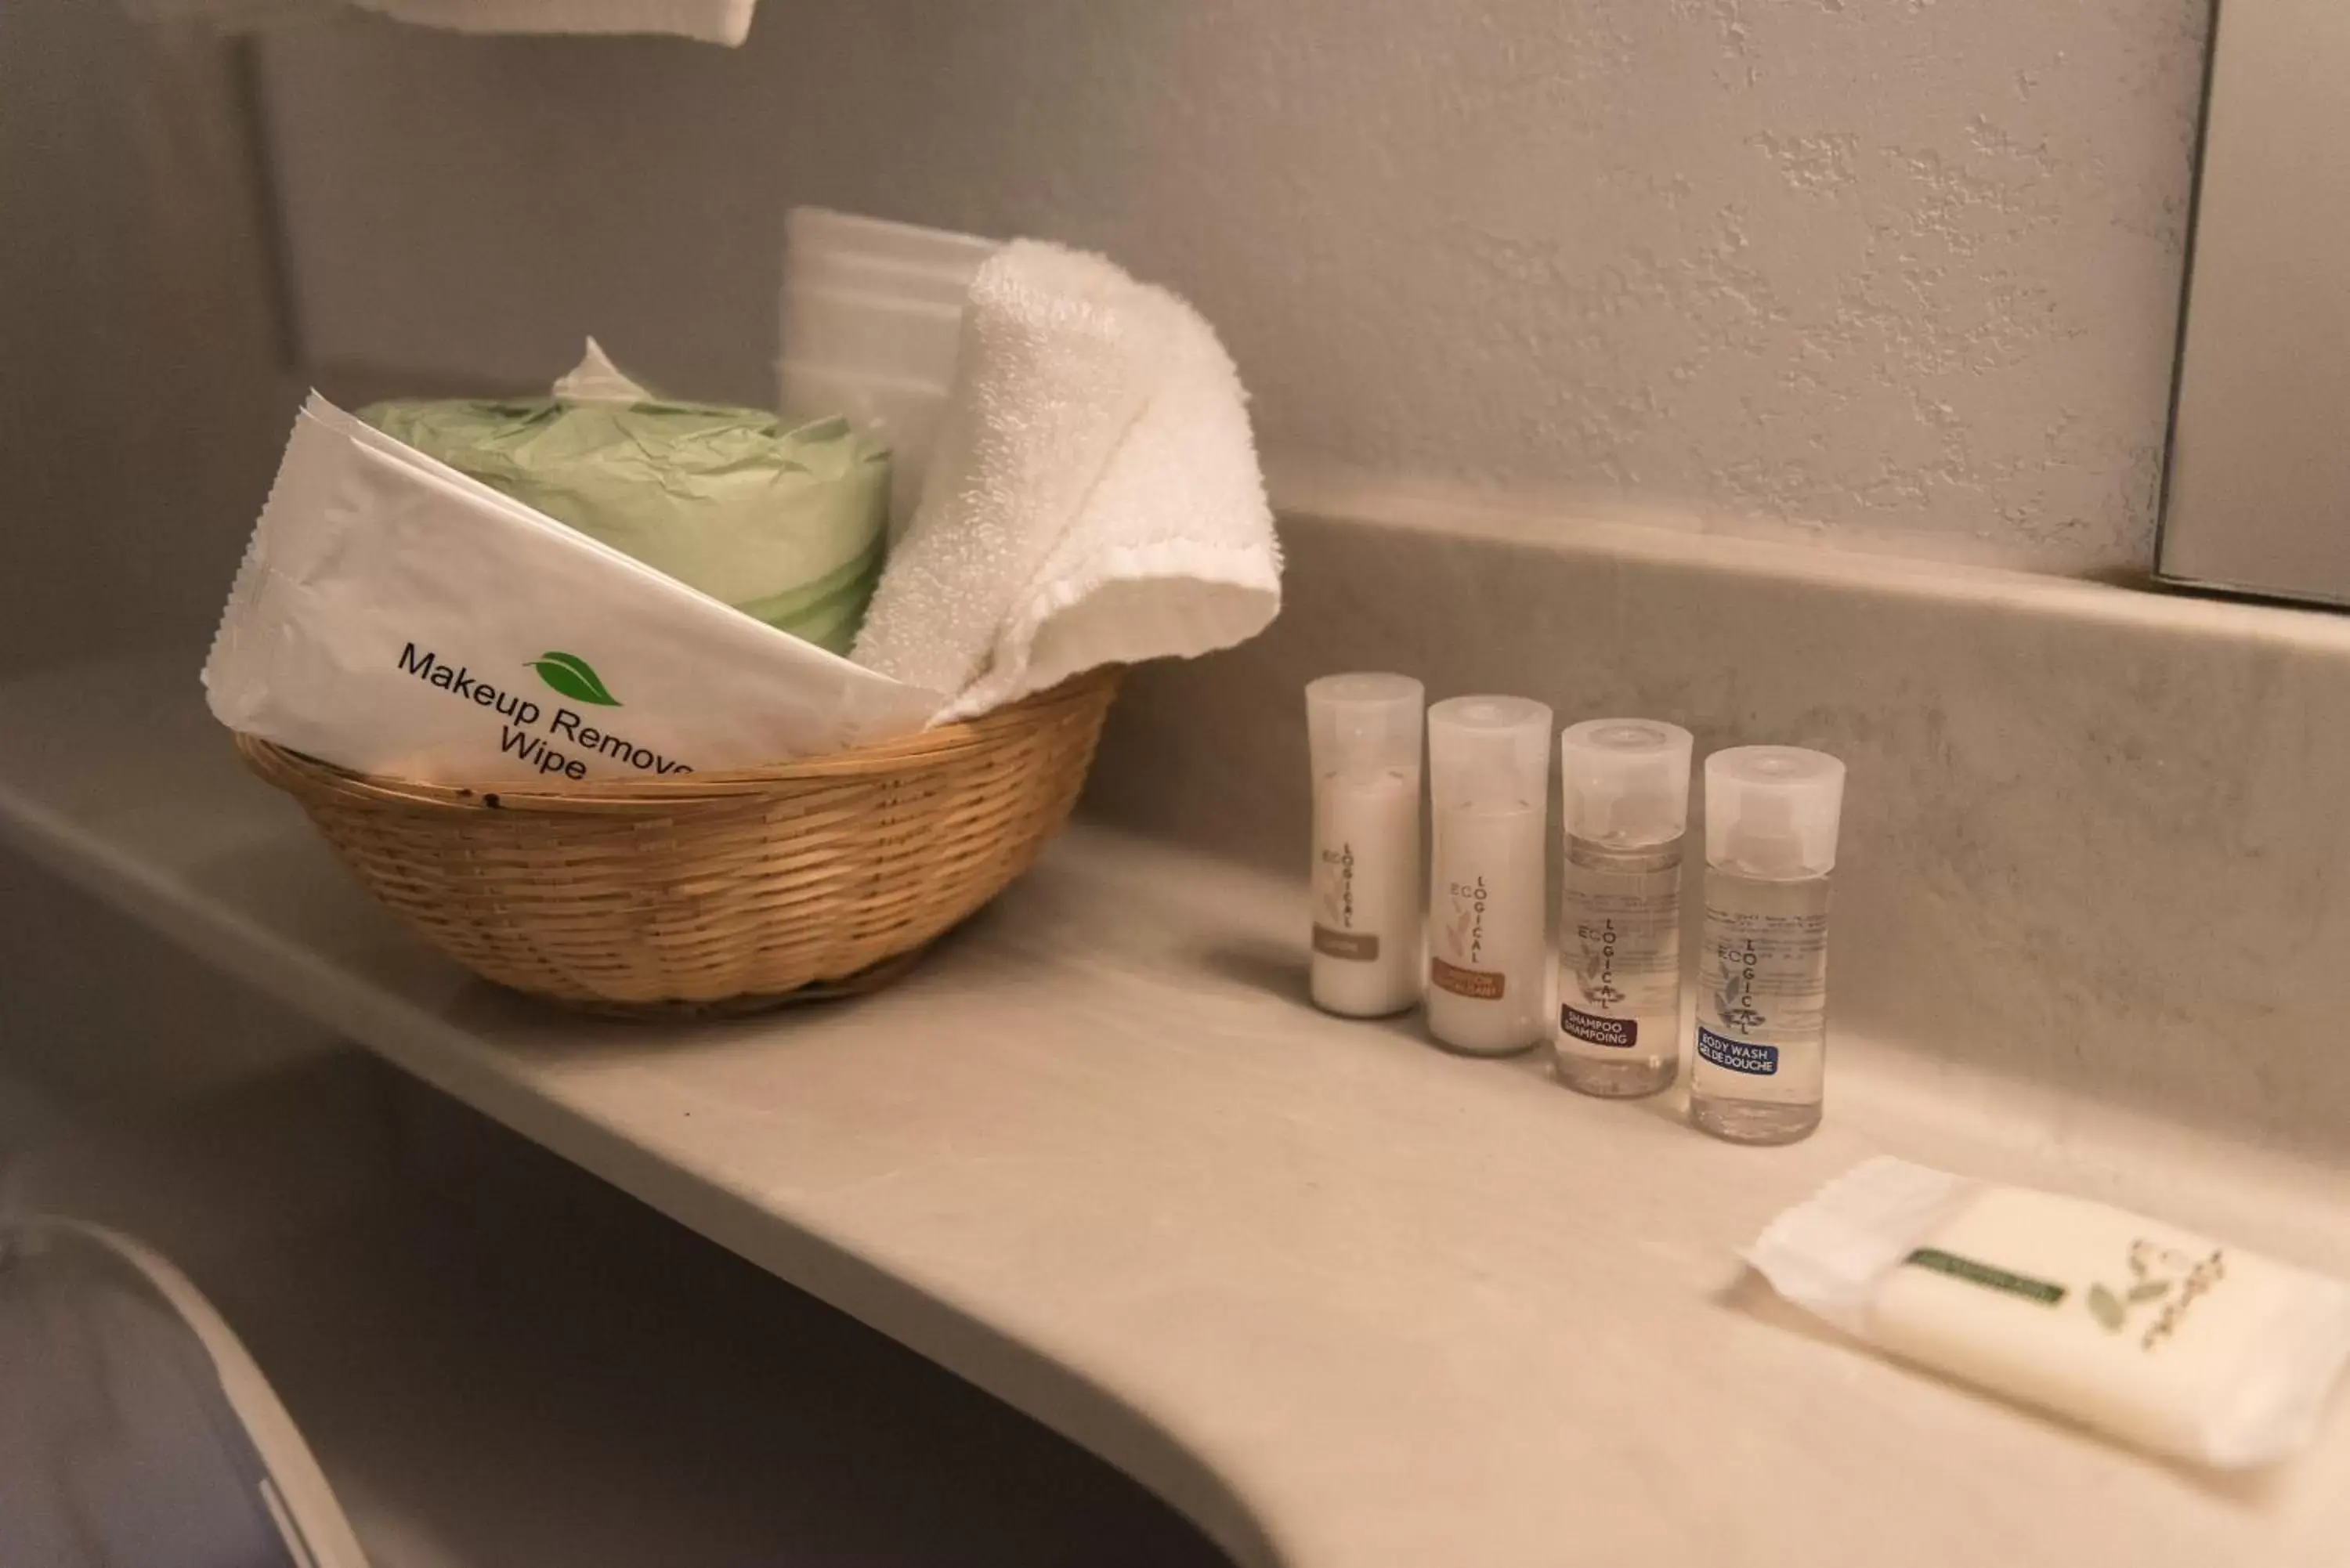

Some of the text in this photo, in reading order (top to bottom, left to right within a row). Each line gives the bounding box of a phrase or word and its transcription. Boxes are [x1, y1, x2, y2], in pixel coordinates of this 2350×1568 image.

[398, 642, 540, 726] Makeup
[501, 725, 587, 779] Wipe
[1471, 876, 1487, 963] LOGICAL
[1602, 919, 1617, 1009] LOGICAL
[1741, 940, 1757, 1035] LOGICAL
[1564, 1019, 1628, 1045] SHAMPOING
[1568, 1011, 1622, 1033] SHAMPOO
[1702, 1033, 1768, 1060] BODY WASH
[1712, 1050, 1724, 1063] DE
[1724, 1055, 1775, 1072] DOUCHE
